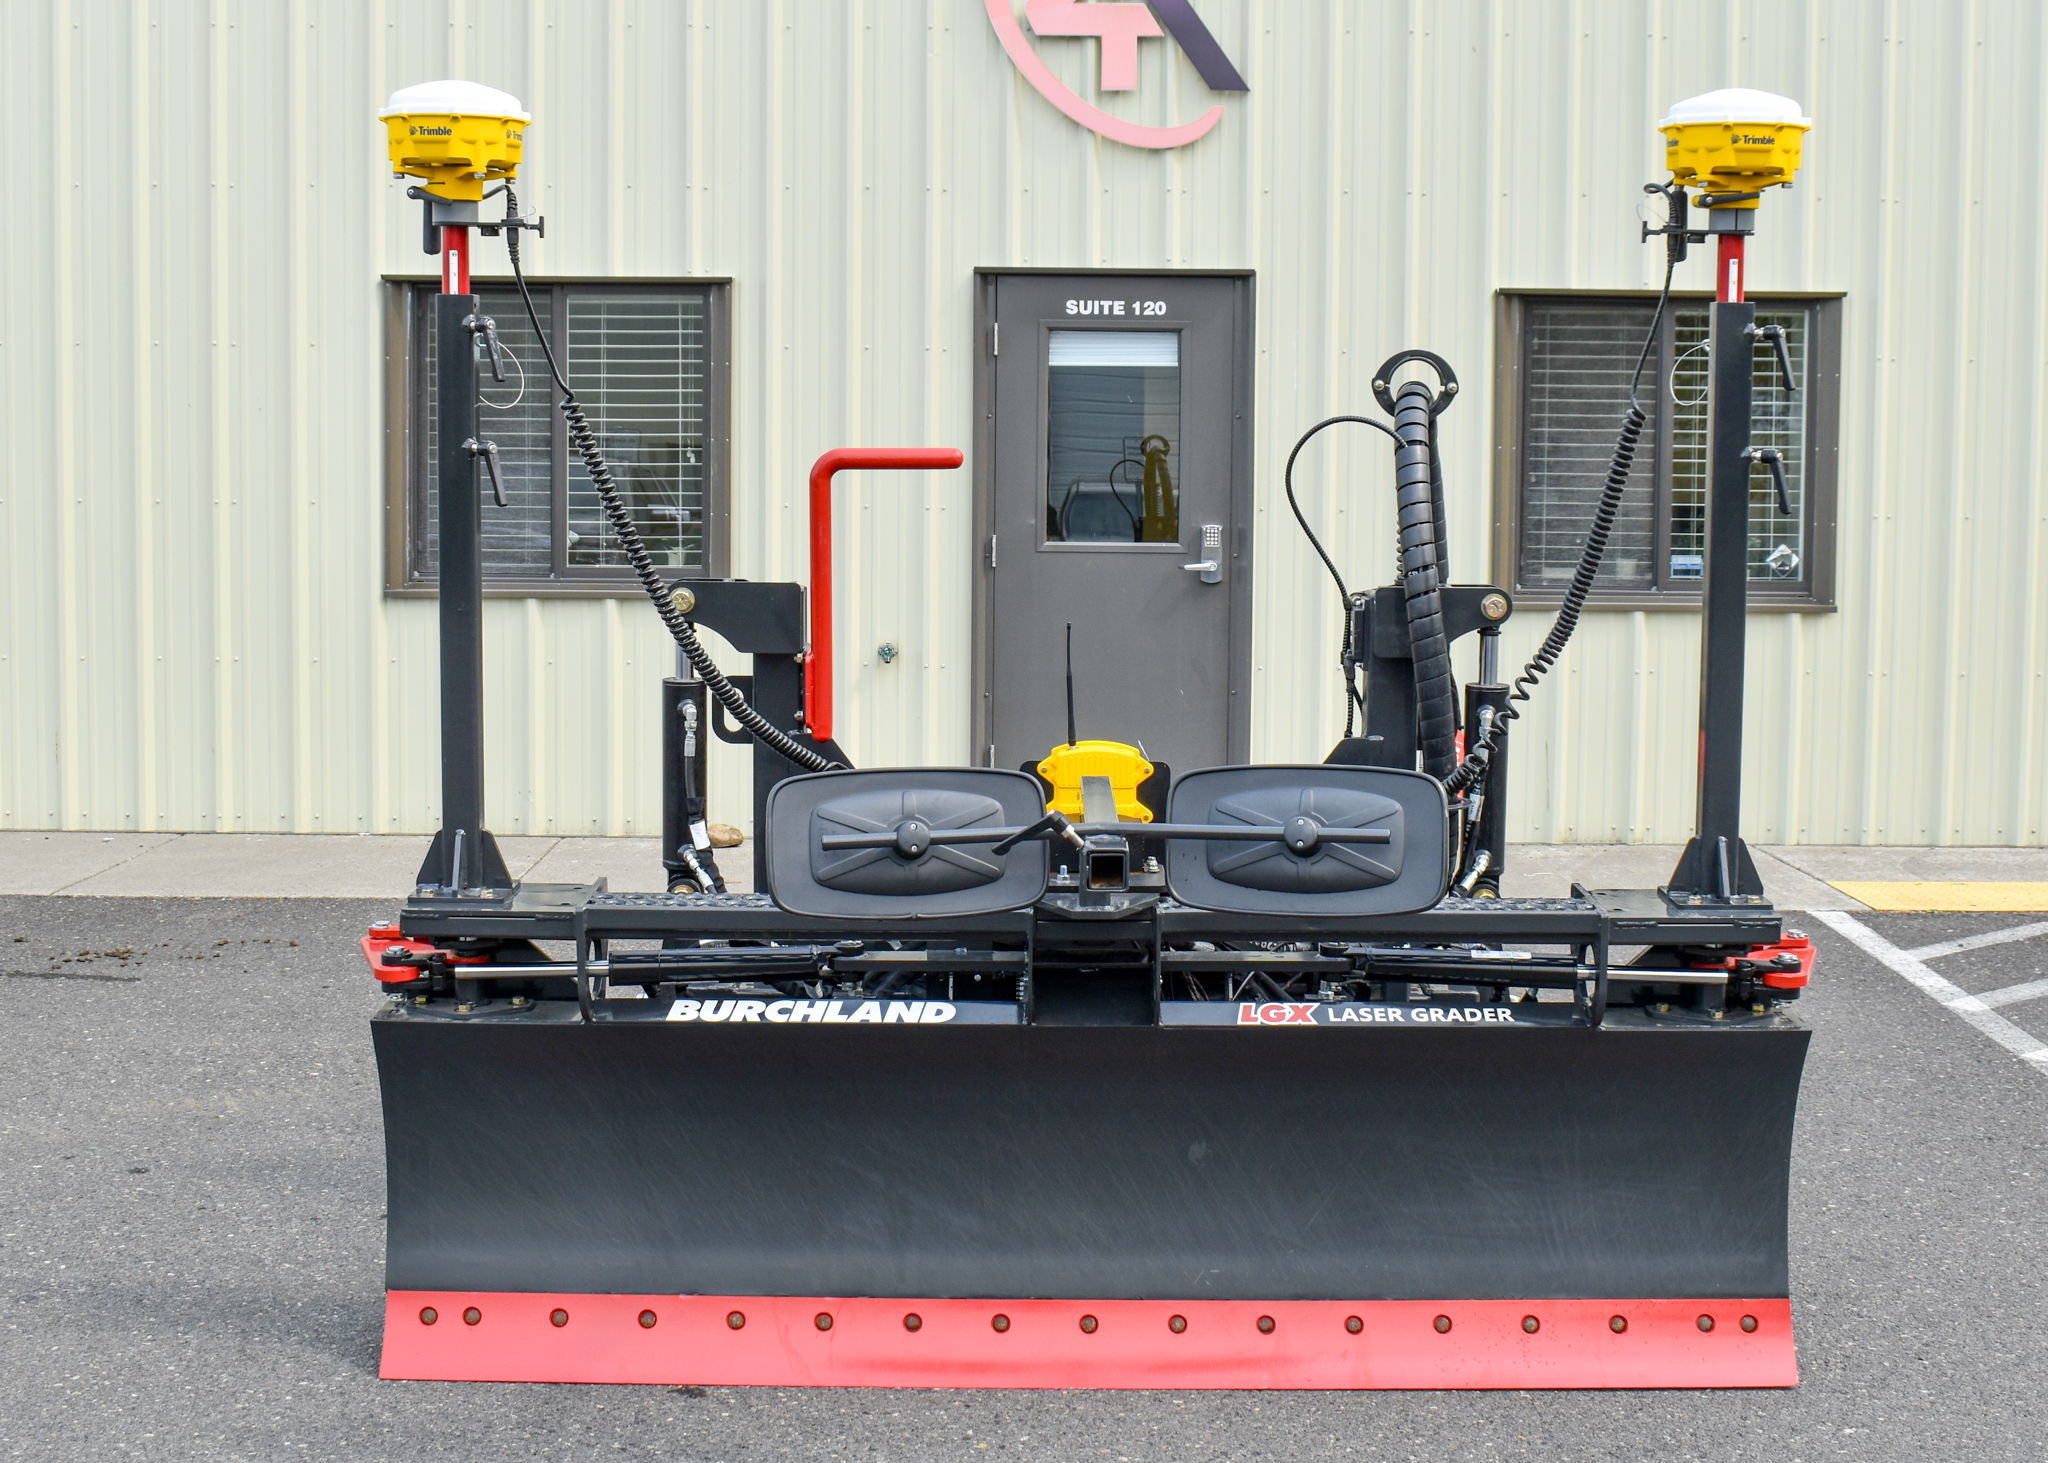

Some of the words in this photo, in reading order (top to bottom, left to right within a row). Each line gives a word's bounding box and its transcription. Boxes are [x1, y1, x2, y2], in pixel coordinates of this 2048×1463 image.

[418, 125, 452, 136] Trimble
[1743, 134, 1776, 145] Trimble
[1065, 299, 1126, 315] SUITE
[1132, 300, 1167, 315] 120
[665, 999, 957, 1024] BURCHLAND
[1237, 1002, 1320, 1026] LGX
[1328, 1007, 1406, 1023] LASER
[1411, 1007, 1516, 1023] GRADER
